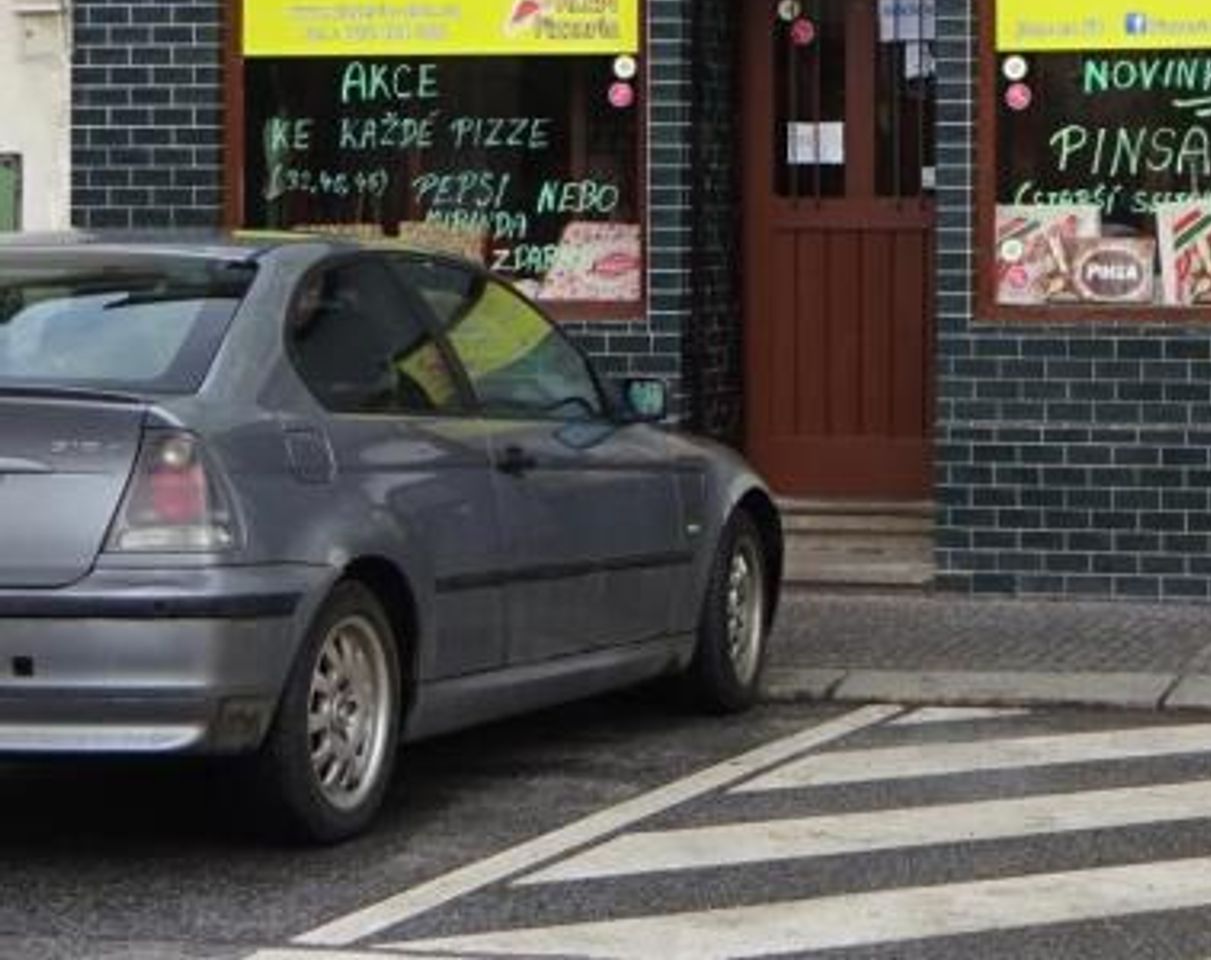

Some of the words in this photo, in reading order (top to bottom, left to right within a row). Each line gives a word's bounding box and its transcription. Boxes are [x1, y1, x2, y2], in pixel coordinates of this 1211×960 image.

[341, 61, 439, 103] AKCE
[339, 110, 438, 149] KAŽDÉ
[450, 117, 554, 149] PIZZE
[1049, 125, 1211, 176] PINSA
[412, 170, 511, 208] PEPSI
[536, 178, 620, 214] NEBO
[1085, 261, 1138, 282] PINSA
